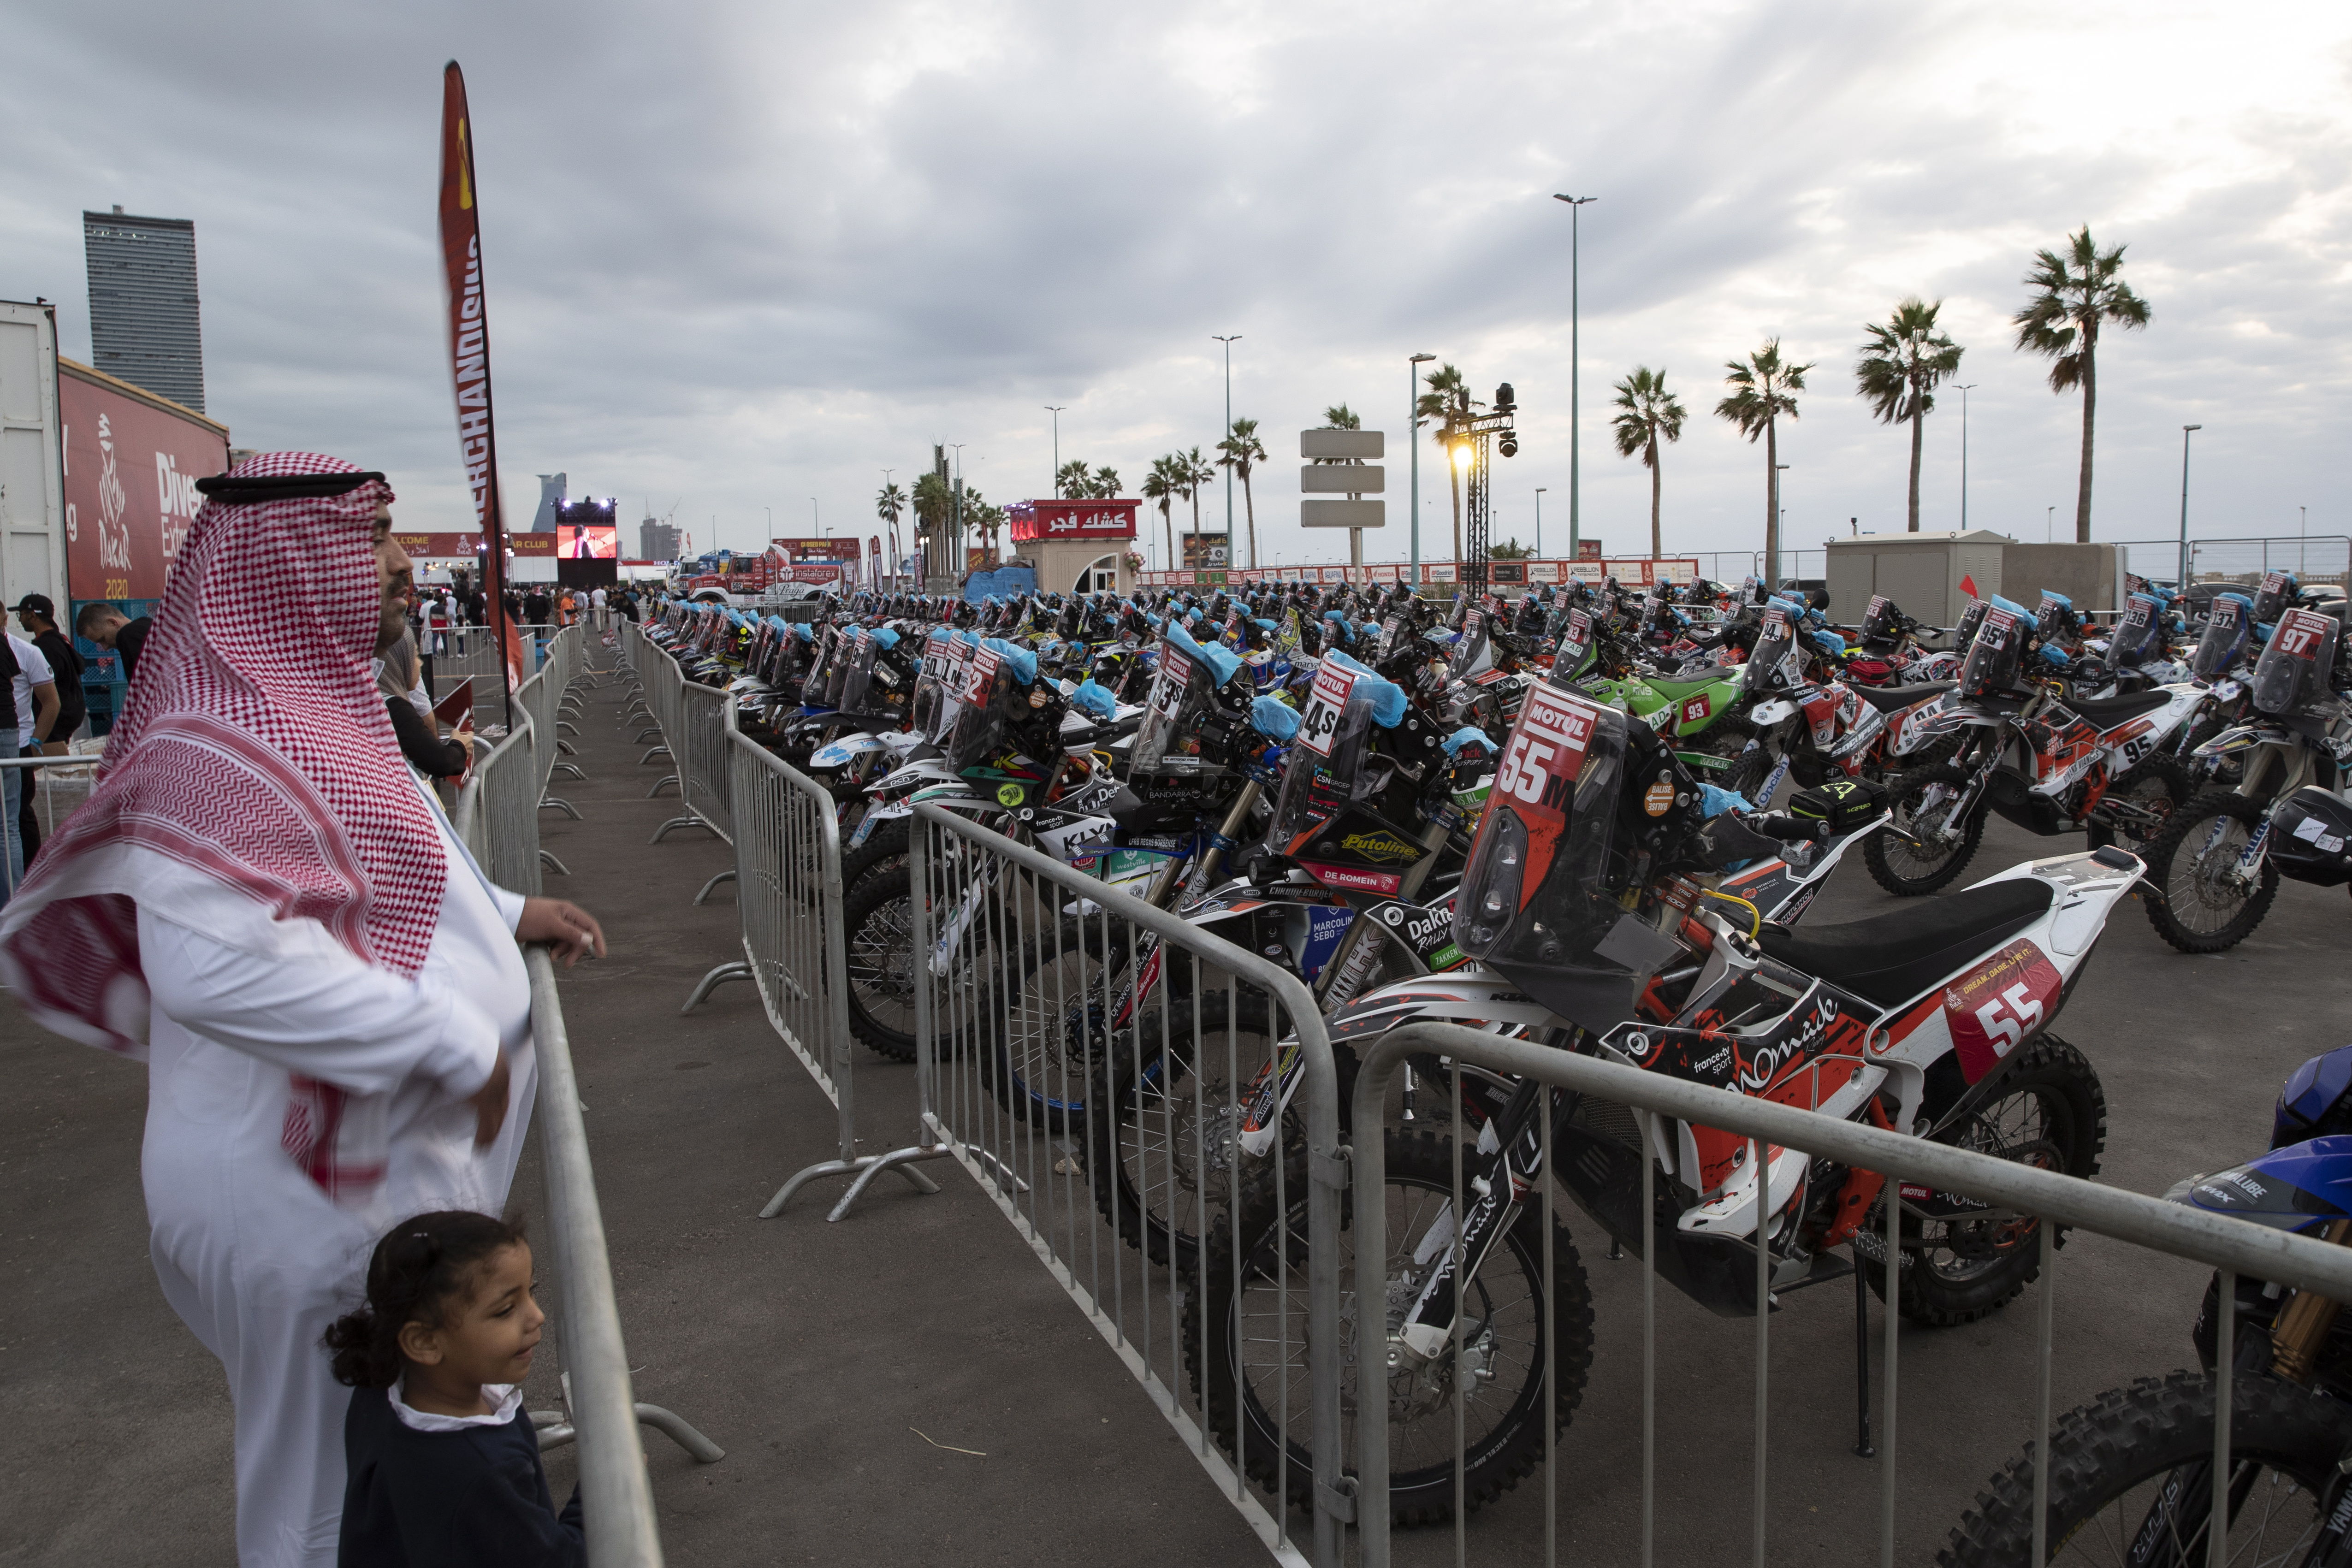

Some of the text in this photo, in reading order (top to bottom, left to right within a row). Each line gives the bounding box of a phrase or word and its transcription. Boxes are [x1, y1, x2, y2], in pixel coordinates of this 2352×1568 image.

[1048, 511, 1127, 532] كشك فجر
[98, 518, 132, 572] DAKAR
[525, 540, 548, 549] CLUB
[795, 568, 835, 577] instaforex
[106, 579, 128, 599] 2020
[779, 585, 805, 597] Praga
[2262, 581, 2281, 593] 158
[1867, 604, 1878, 617] 33
[1991, 614, 2011, 626] MOTUL
[2295, 617, 2324, 629] MOTUL
[1979, 623, 2009, 646] 95M
[931, 645, 945, 653] MOTUL
[2281, 628, 2317, 657] 97M
[763, 640, 775, 667] AUTONET
[851, 647, 864, 665] 9M
[975, 652, 995, 669] MOTUL
[1776, 651, 1789, 667] BURGA
[923, 656, 941, 681] 50S
[1168, 656, 1188, 676] MOTUL
[1580, 657, 1597, 674] MACAD
[1317, 671, 1346, 695] MOTUL
[946, 692, 957, 702] CIRCA
[1794, 687, 1815, 697] MOBO
[1688, 702, 1705, 720] 93
[1529, 704, 1585, 737] MOTUL
[2124, 734, 2152, 763] 95
[1700, 758, 1729, 769] MACAD
[890, 775, 910, 787] pch
[1149, 791, 1191, 799] BANDARRA
[1651, 785, 1672, 794] BALISE
[1453, 792, 1480, 806] ERS.NL
[1440, 809, 1455, 820] XTRIG
[1647, 803, 1668, 812] BALISE
[1846, 802, 1871, 813] ACERBIS
[1049, 820, 1064, 829] sport
[1435, 817, 1451, 828] ROCS
[1140, 838, 1154, 846] REGAS
[1155, 839, 1176, 848] BORBENSE
[1346, 835, 1415, 856] Putoline
[1074, 862, 1096, 870] ENTRUM
[1117, 858, 1146, 870] westville
[1324, 870, 1377, 886] DE ROMEIN
[1756, 878, 1777, 890] MOTORCYCLE
[1673, 884, 1692, 899] XTRIG
[1665, 894, 1687, 909] ROCS
[1781, 888, 1813, 923] HULSHOF
[1314, 930, 1335, 942] SEBO
[1416, 927, 1451, 954] RALLY
[1962, 948, 2032, 995] DREAM. DARE. LIVE IT.
[1949, 998, 1963, 1010] DAKAR
[1955, 1004, 1964, 1012] 2020
[1975, 981, 2043, 1059] 55
[1278, 1045, 1297, 1075] utoline
[1712, 1055, 1732, 1075] sport
[1256, 1090, 1274, 1121] Ameg
[1901, 1187, 1927, 1197] MOTUL
[2326, 1482, 2352, 1535] YAMA
